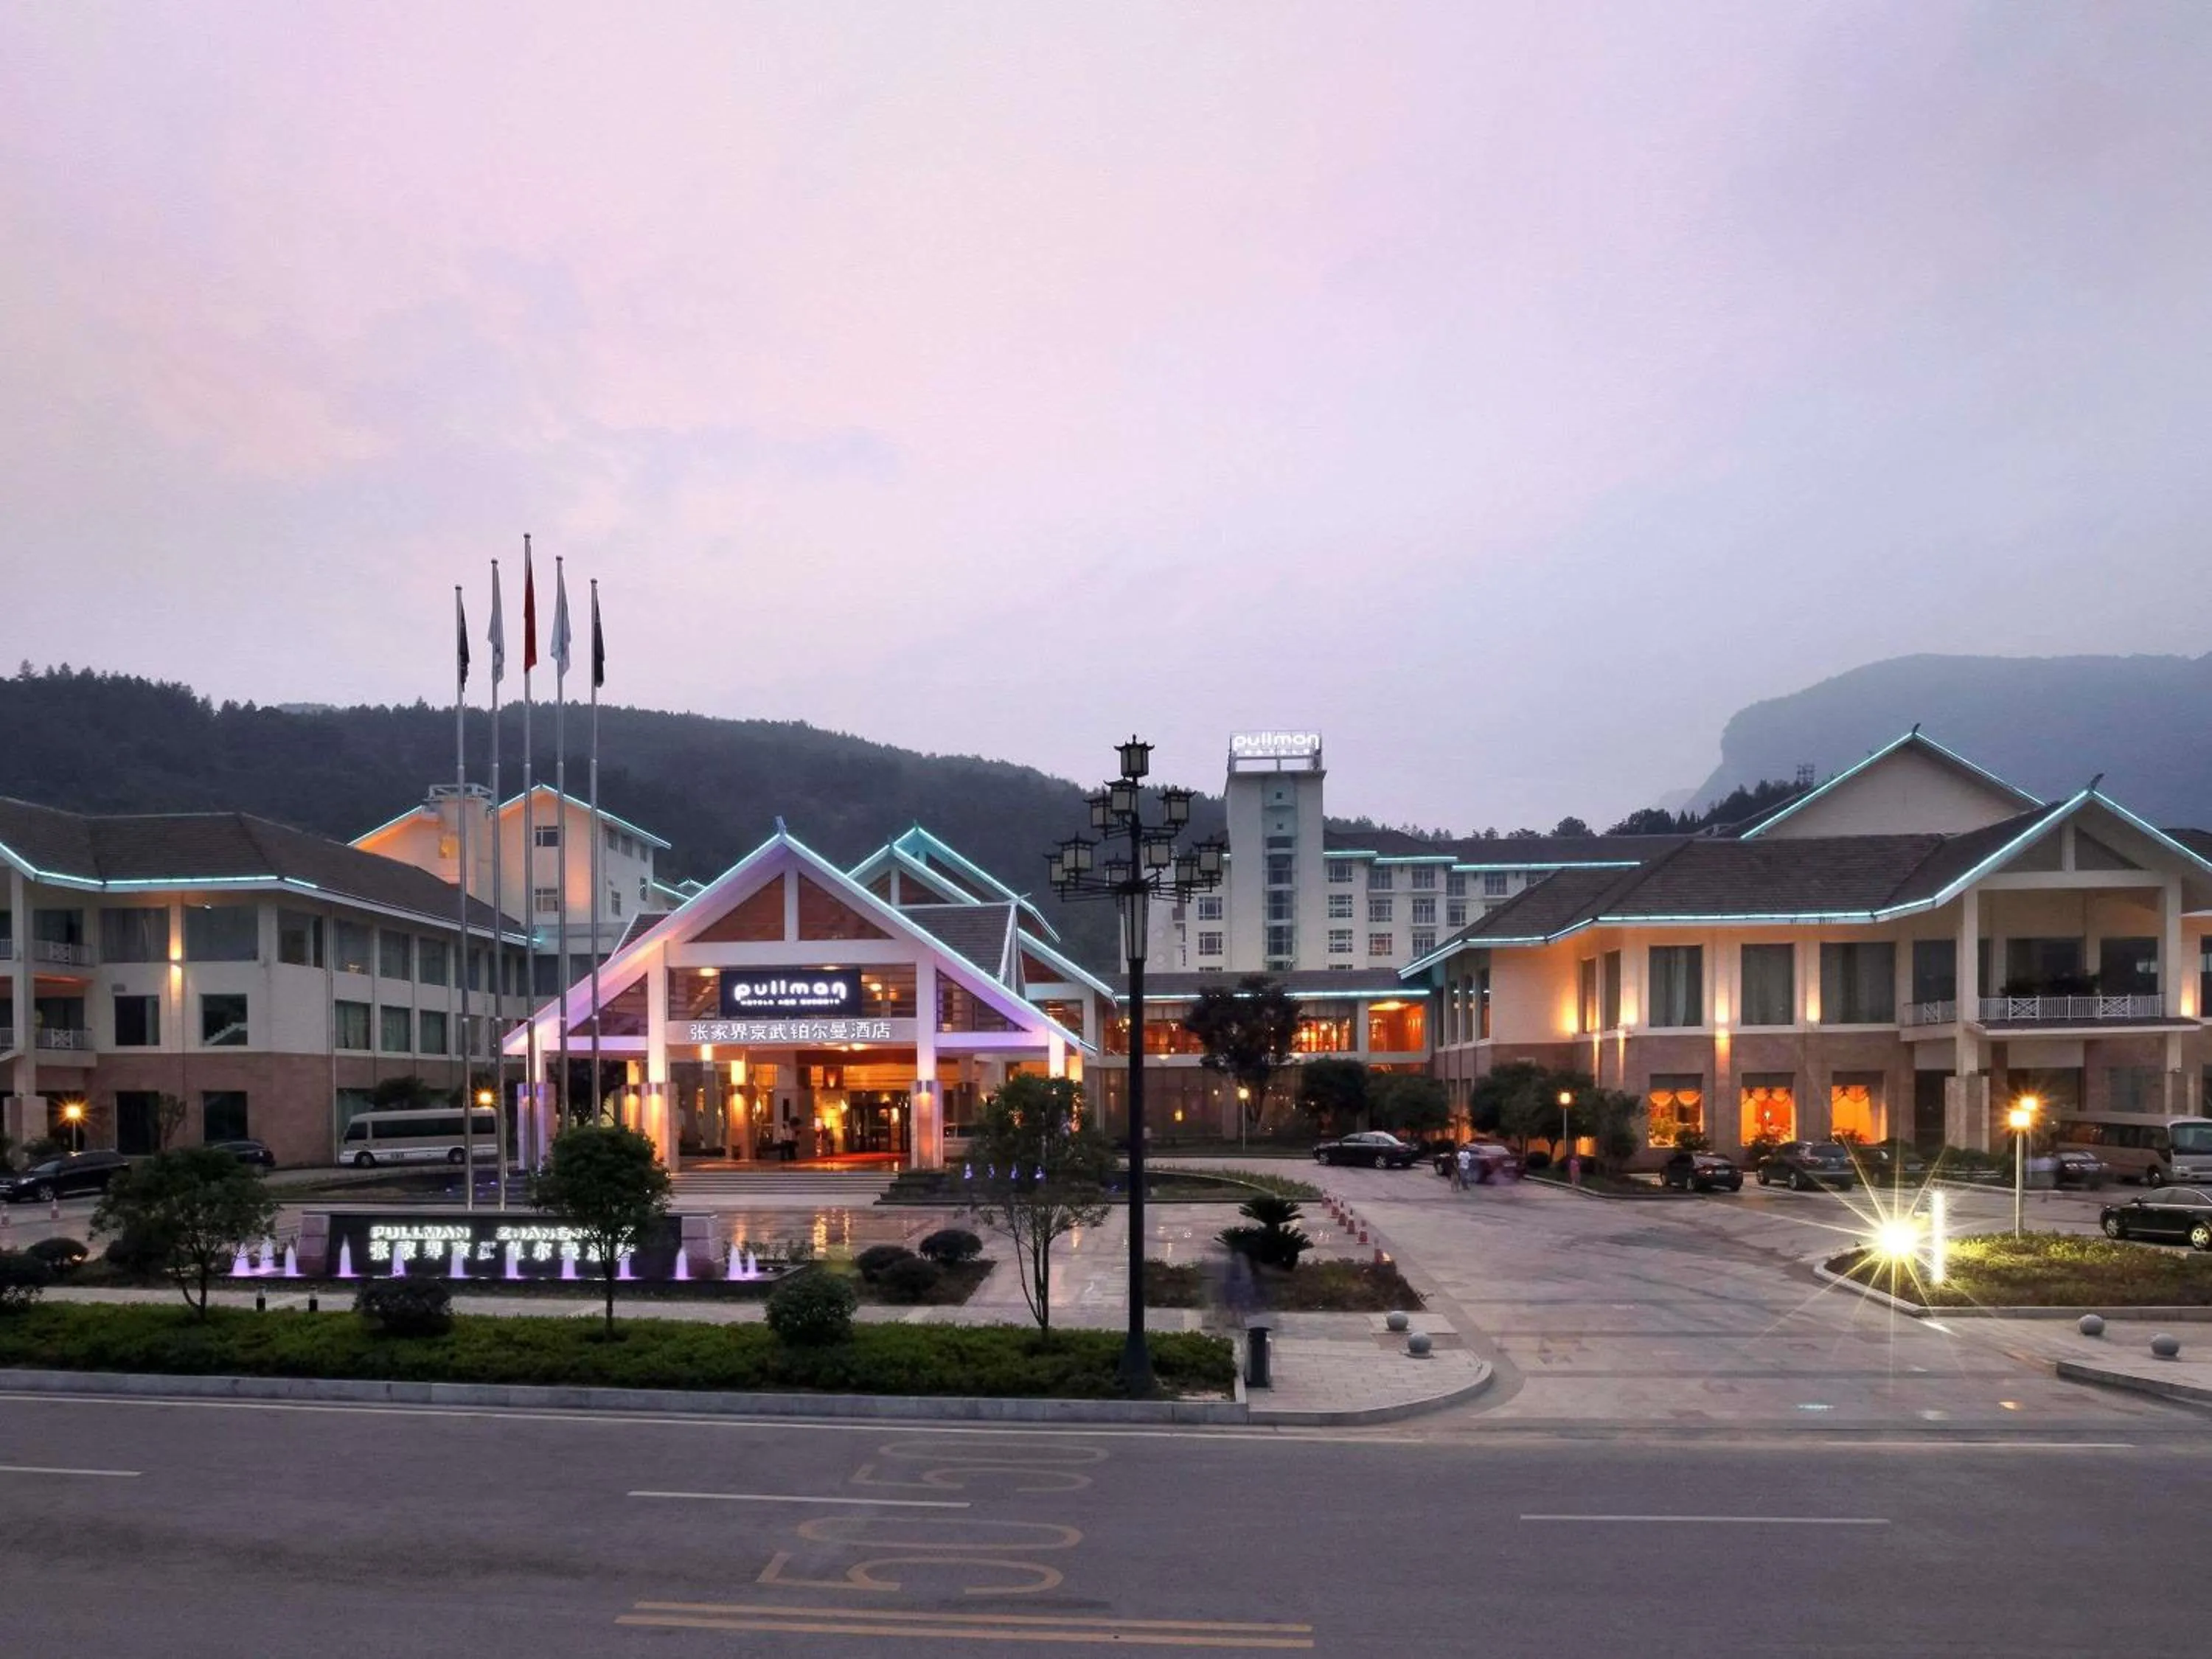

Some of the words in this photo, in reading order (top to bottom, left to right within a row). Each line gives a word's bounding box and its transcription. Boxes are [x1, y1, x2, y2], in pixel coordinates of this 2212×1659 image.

[1233, 731, 1320, 751] pullman
[734, 979, 847, 1001] pullman
[689, 1021, 891, 1040] 张家界京武铂尔曼酒店
[369, 1225, 472, 1240] PULLMAN
[755, 1515, 1085, 1595] 50
